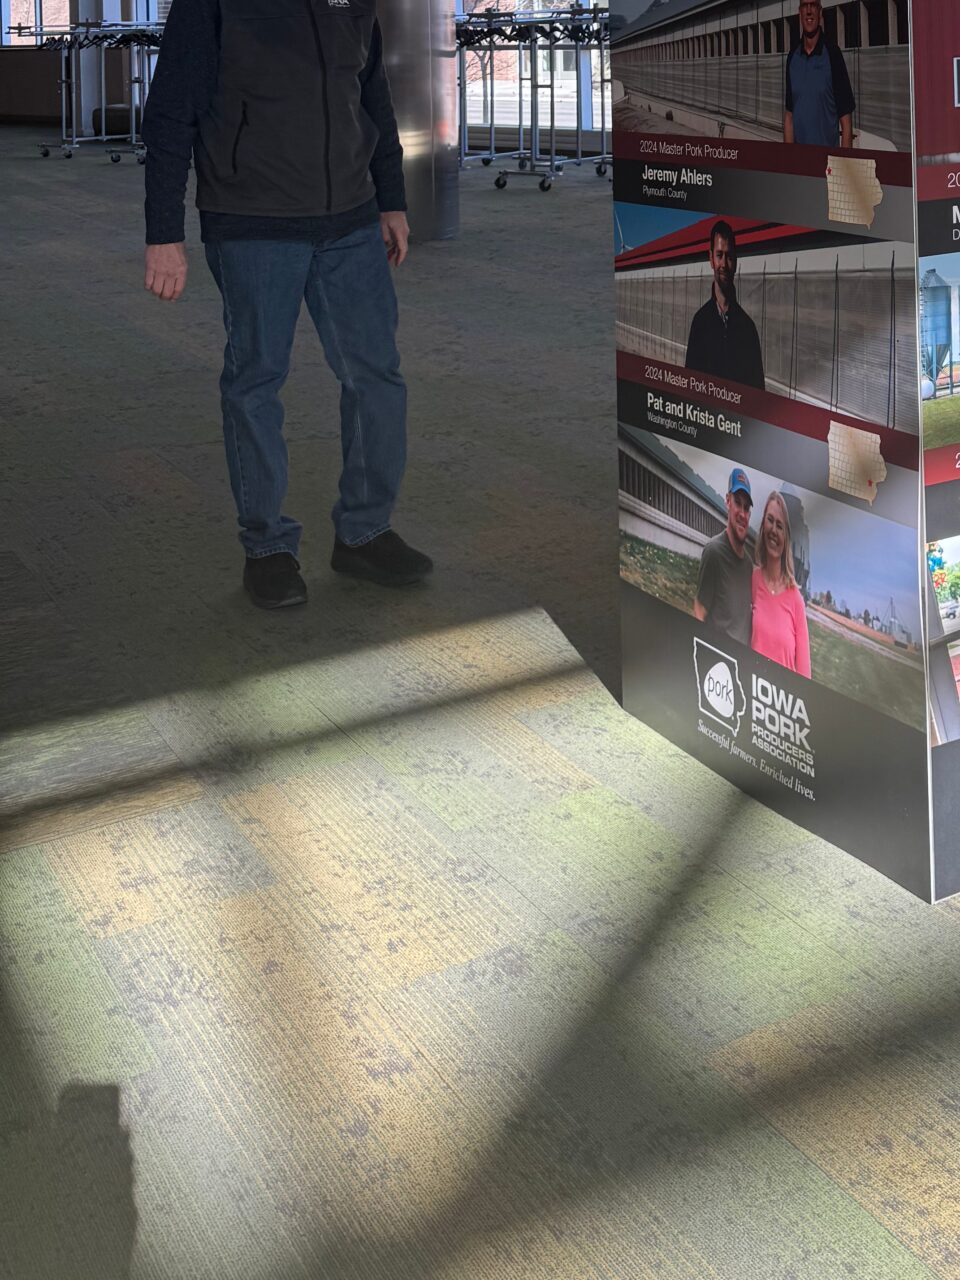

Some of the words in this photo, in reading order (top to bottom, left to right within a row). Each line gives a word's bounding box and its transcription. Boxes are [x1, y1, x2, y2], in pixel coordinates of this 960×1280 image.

[640, 140, 657, 153] 2024
[660, 142, 683, 155] Master
[686, 143, 702, 157] Pork
[704, 144, 739, 160] Producer
[642, 165, 677, 186] Jeremy
[680, 168, 712, 186] Ahlers
[645, 365, 662, 380] 2024
[664, 370, 688, 388] Master
[690, 377, 707, 392] Pork
[708, 383, 742, 404] Producer
[647, 392, 663, 412] Pat
[666, 401, 683, 417] and
[686, 404, 714, 427] Krista
[717, 414, 741, 437] Gent
[708, 673, 733, 705] pork
[752, 673, 811, 726] IOWA
[697, 718, 729, 750] Successful
[729, 742, 757, 768] farmers.
[760, 758, 793, 789] Enriched
[795, 780, 816, 801] lives.
[751, 722, 814, 765] PRODUCERS
[752, 735, 815, 778] ASSOCIATION
